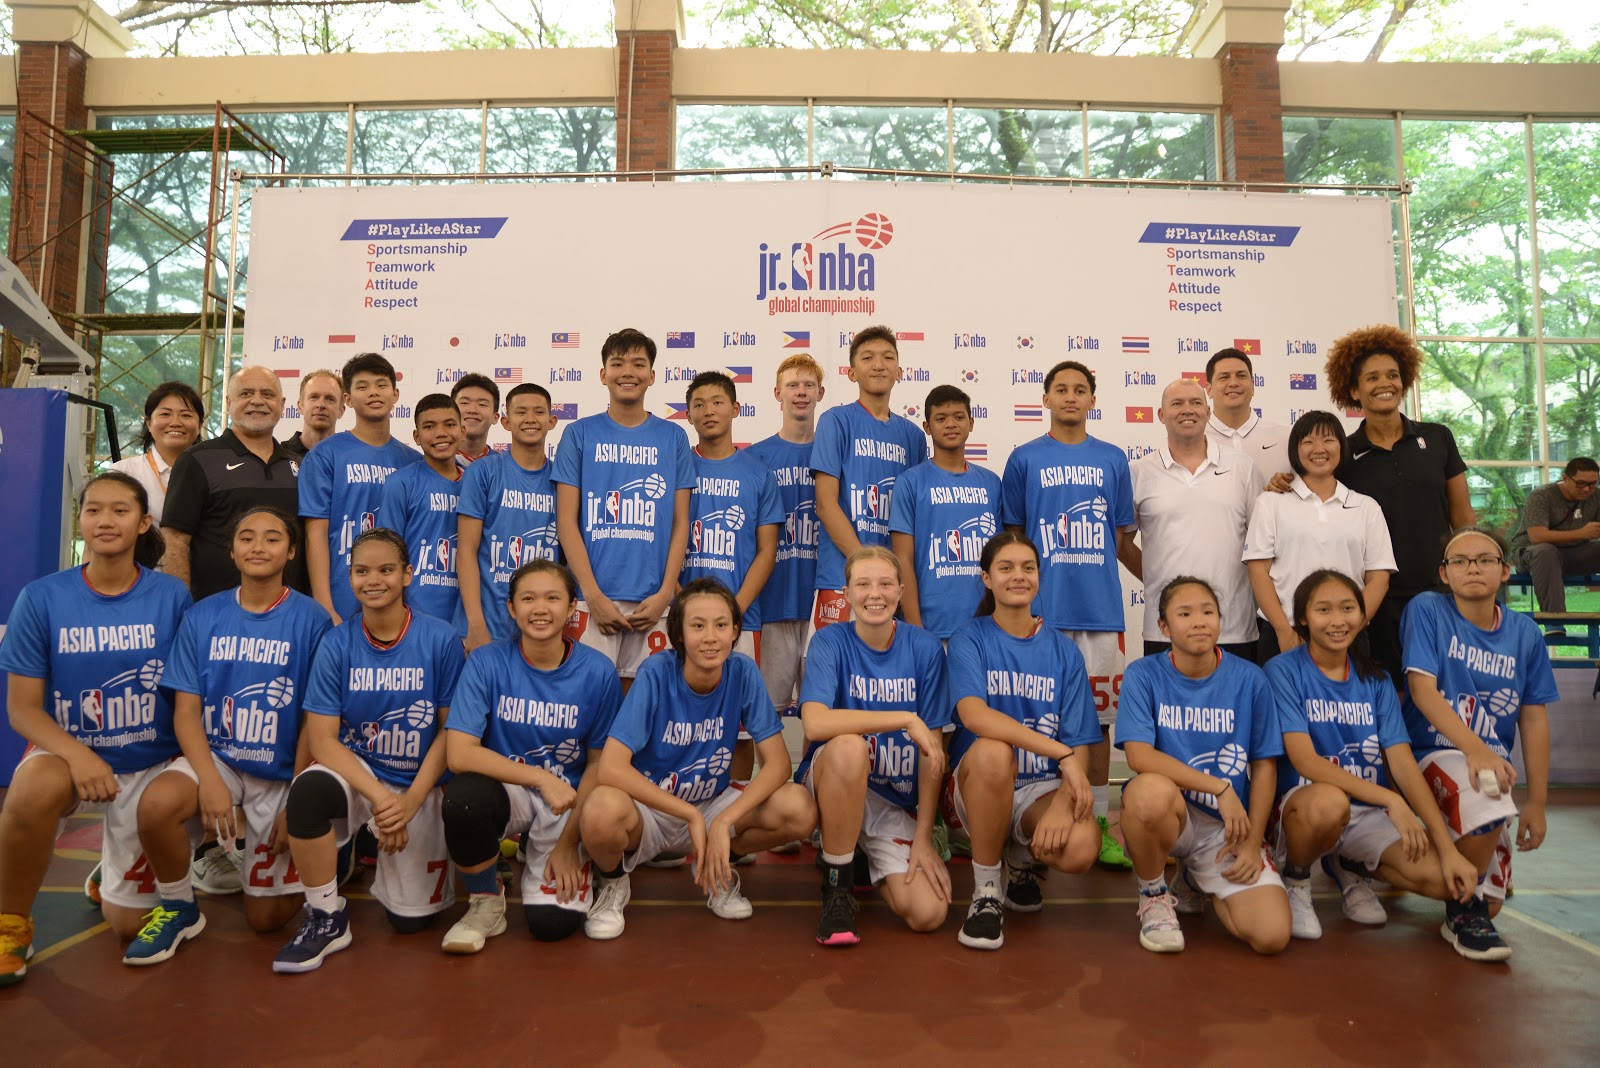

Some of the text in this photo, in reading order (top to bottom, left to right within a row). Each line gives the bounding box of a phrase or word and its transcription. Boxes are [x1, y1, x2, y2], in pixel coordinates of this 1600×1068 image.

[368, 223, 481, 238] #PlayLikeAStar
[1165, 228, 1276, 243] #PlayLikeAStar
[366, 242, 468, 257] Sportsmanship
[1166, 247, 1265, 264] Sportsmanship
[366, 260, 435, 272] Teamwork
[756, 242, 875, 300] jr. nba
[1167, 264, 1236, 278] Teamwork
[364, 278, 418, 290] Attitude
[1168, 282, 1221, 294] Attitude
[364, 296, 418, 310] Respect
[768, 296, 875, 316] global championship
[1169, 300, 1222, 314] Respect
[288, 336, 304, 349] nba
[398, 335, 414, 348] nba
[510, 334, 526, 348] nba
[740, 332, 756, 346] nba
[970, 334, 986, 348] nba
[1084, 336, 1099, 350] nba
[1194, 338, 1208, 352] nba
[1302, 340, 1316, 354] nba
[566, 368, 582, 382] nba
[914, 368, 930, 382] nba
[1028, 370, 1044, 384] nba
[1140, 372, 1156, 386] nba
[1254, 374, 1264, 387] ba
[396, 405, 410, 418] nba
[740, 403, 756, 416] nba
[972, 405, 988, 418] nba
[595, 443, 658, 466] ASIA PACIFIC
[854, 438, 876, 457] ASIA
[346, 464, 372, 484] ASIA
[1040, 466, 1104, 488] ASIA PACIFIC
[702, 478, 740, 498] PACIFIC
[930, 486, 988, 505] ASIA PACIFIC
[430, 492, 449, 512] ASIA
[501, 488, 523, 509] ASIA
[586, 492, 656, 532] jr. nba
[592, 526, 654, 544] global championship
[703, 522, 736, 556] nba
[1040, 514, 1104, 558] jr. nba
[414, 539, 434, 576] jr.
[490, 534, 505, 572] jr.
[929, 530, 989, 570] jr. nb
[694, 556, 735, 572] championship
[936, 564, 955, 578] global
[420, 572, 440, 586] global
[58, 623, 156, 654] ASIA PACIFIC
[210, 636, 291, 666] ASIA PACIFIC
[1466, 645, 1516, 680] PACIFIC
[376, 668, 424, 691] PACIFIC
[869, 678, 916, 702] PACIFIC
[106, 686, 156, 730] nba
[497, 694, 578, 729] ASIA PACIFIC
[1306, 699, 1374, 726] ASIA PACIFIC
[236, 700, 278, 745] nba
[1158, 702, 1234, 734] ASIA PACIFIC
[94, 727, 157, 748] championship
[376, 724, 420, 758] nba
[662, 720, 692, 746] ASIA
[878, 738, 914, 777] nba
[676, 774, 718, 802] nba
[124, 852, 157, 894] 4
[427, 860, 448, 904] 7
